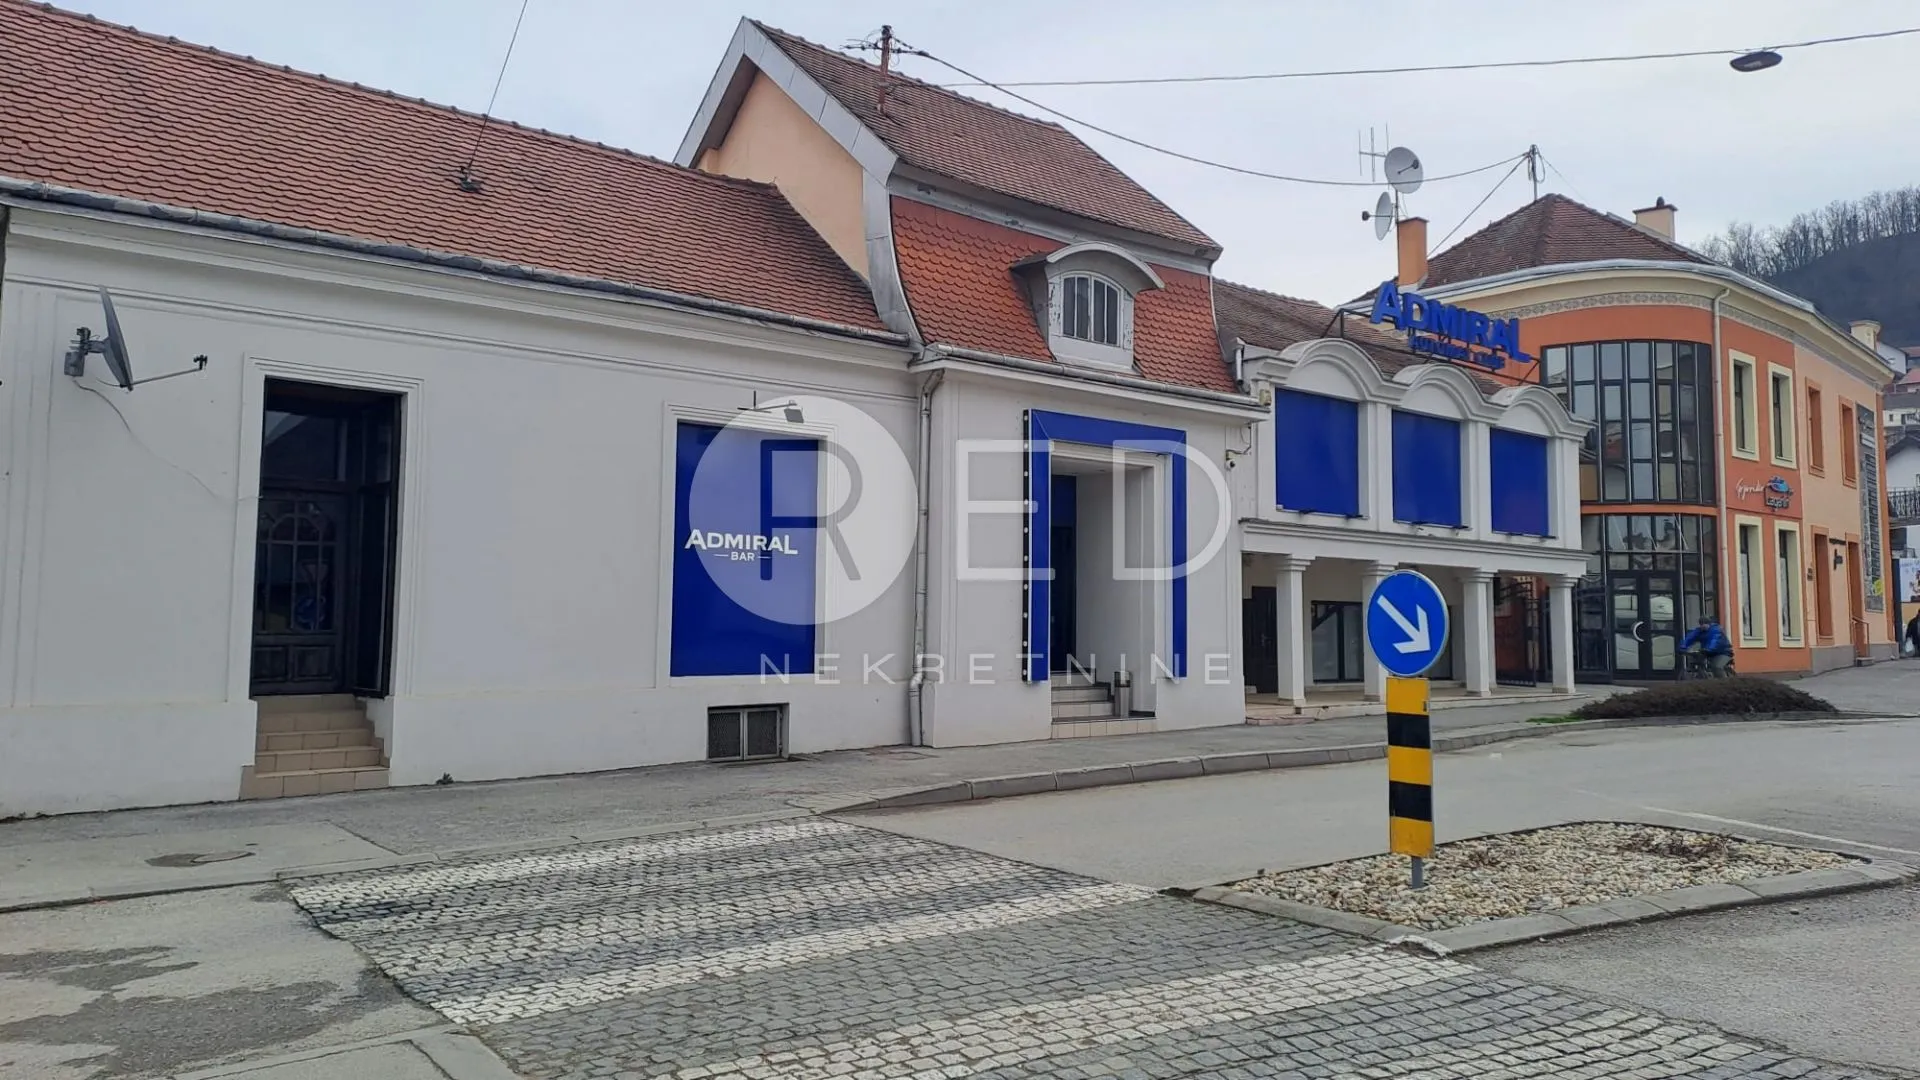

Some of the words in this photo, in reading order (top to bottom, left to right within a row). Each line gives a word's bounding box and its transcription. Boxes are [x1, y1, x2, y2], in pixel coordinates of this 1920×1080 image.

[1370, 280, 1532, 363] ADMIRAL
[685, 528, 799, 555] ADMIRAL
[730, 551, 756, 562] BAR
